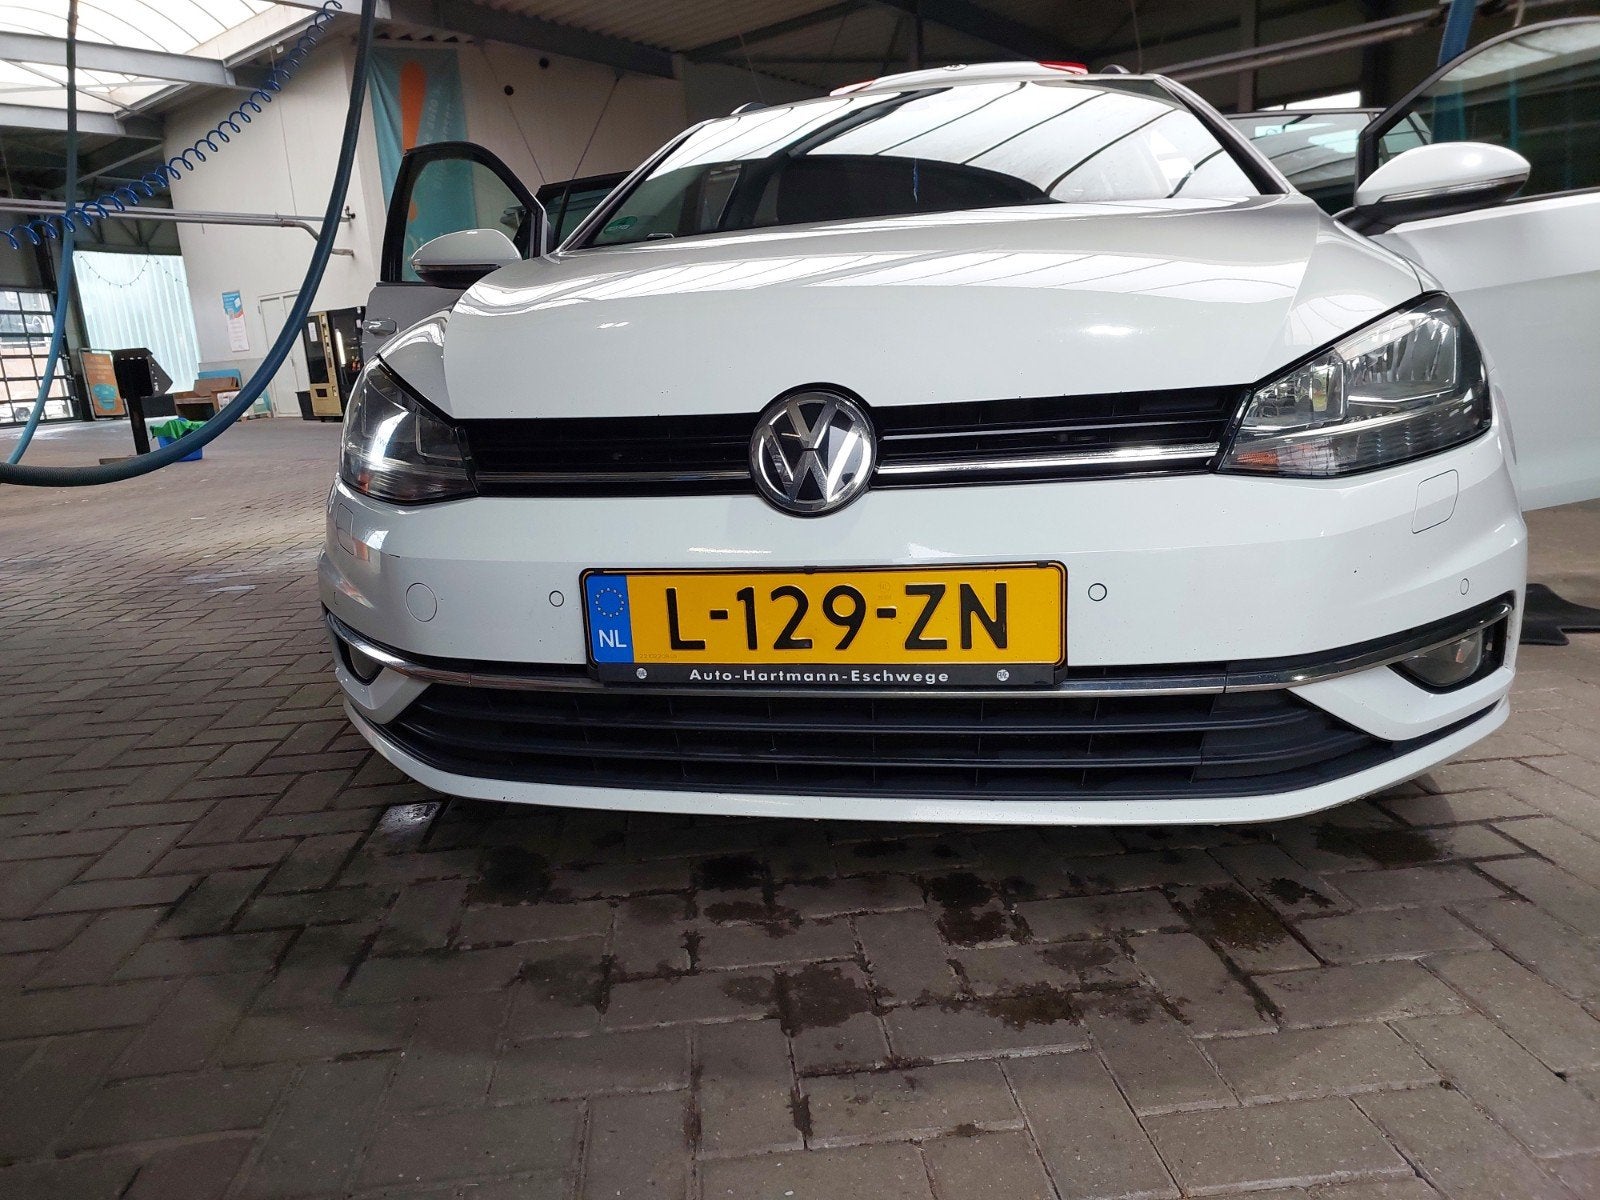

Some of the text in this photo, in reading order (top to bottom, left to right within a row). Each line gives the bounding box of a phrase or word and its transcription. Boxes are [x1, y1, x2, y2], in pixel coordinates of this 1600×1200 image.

[665, 582, 1008, 651] L-129-ZN
[598, 628, 628, 649] NL
[689, 669, 949, 685] Auto-Hartmann-Eschwege
